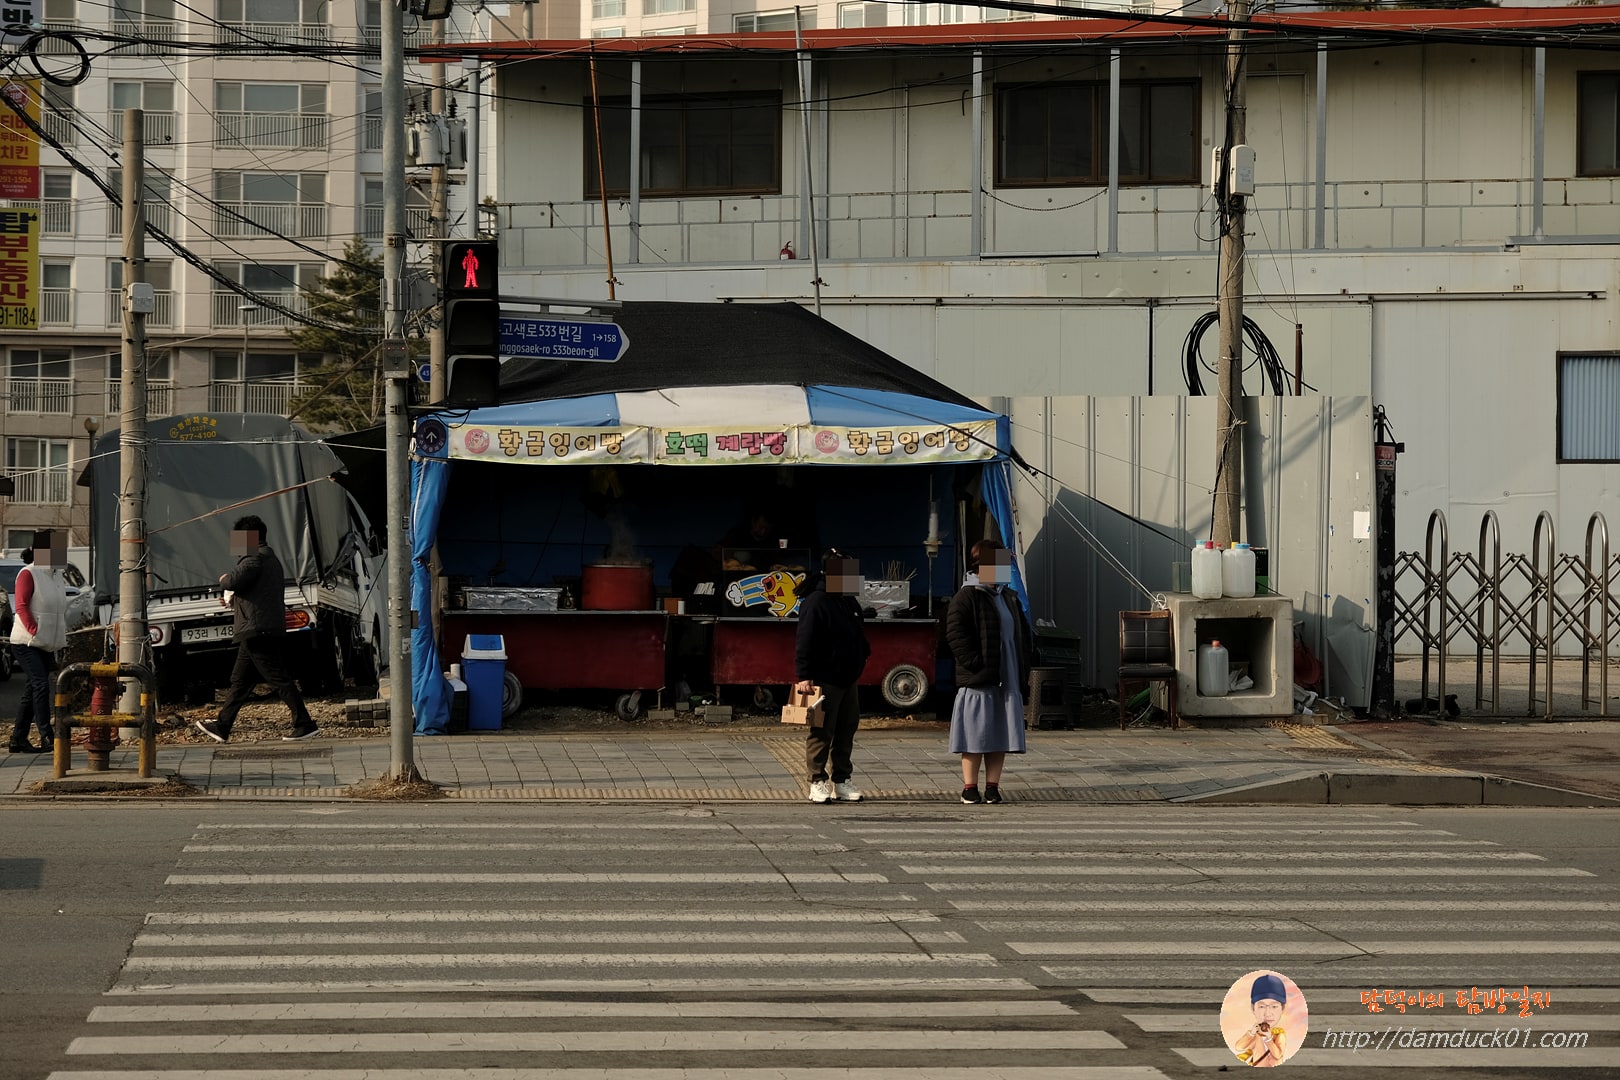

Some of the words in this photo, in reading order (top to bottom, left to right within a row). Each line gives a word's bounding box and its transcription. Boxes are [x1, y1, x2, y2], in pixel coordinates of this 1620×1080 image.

[1, 145, 28, 160] 치킨
[499, 322, 582, 343] 고색로533번길
[499, 343, 551, 355] nggosaek-ro
[552, 344, 600, 359] 533beon-gil
[179, 430, 217, 441] 577-4100
[498, 428, 625, 457] 황금잉어빵
[665, 431, 709, 457] 호떡
[715, 431, 788, 456] 계란빵
[847, 429, 973, 456] 황금잉어빵
[214, 625, 235, 638] 148
